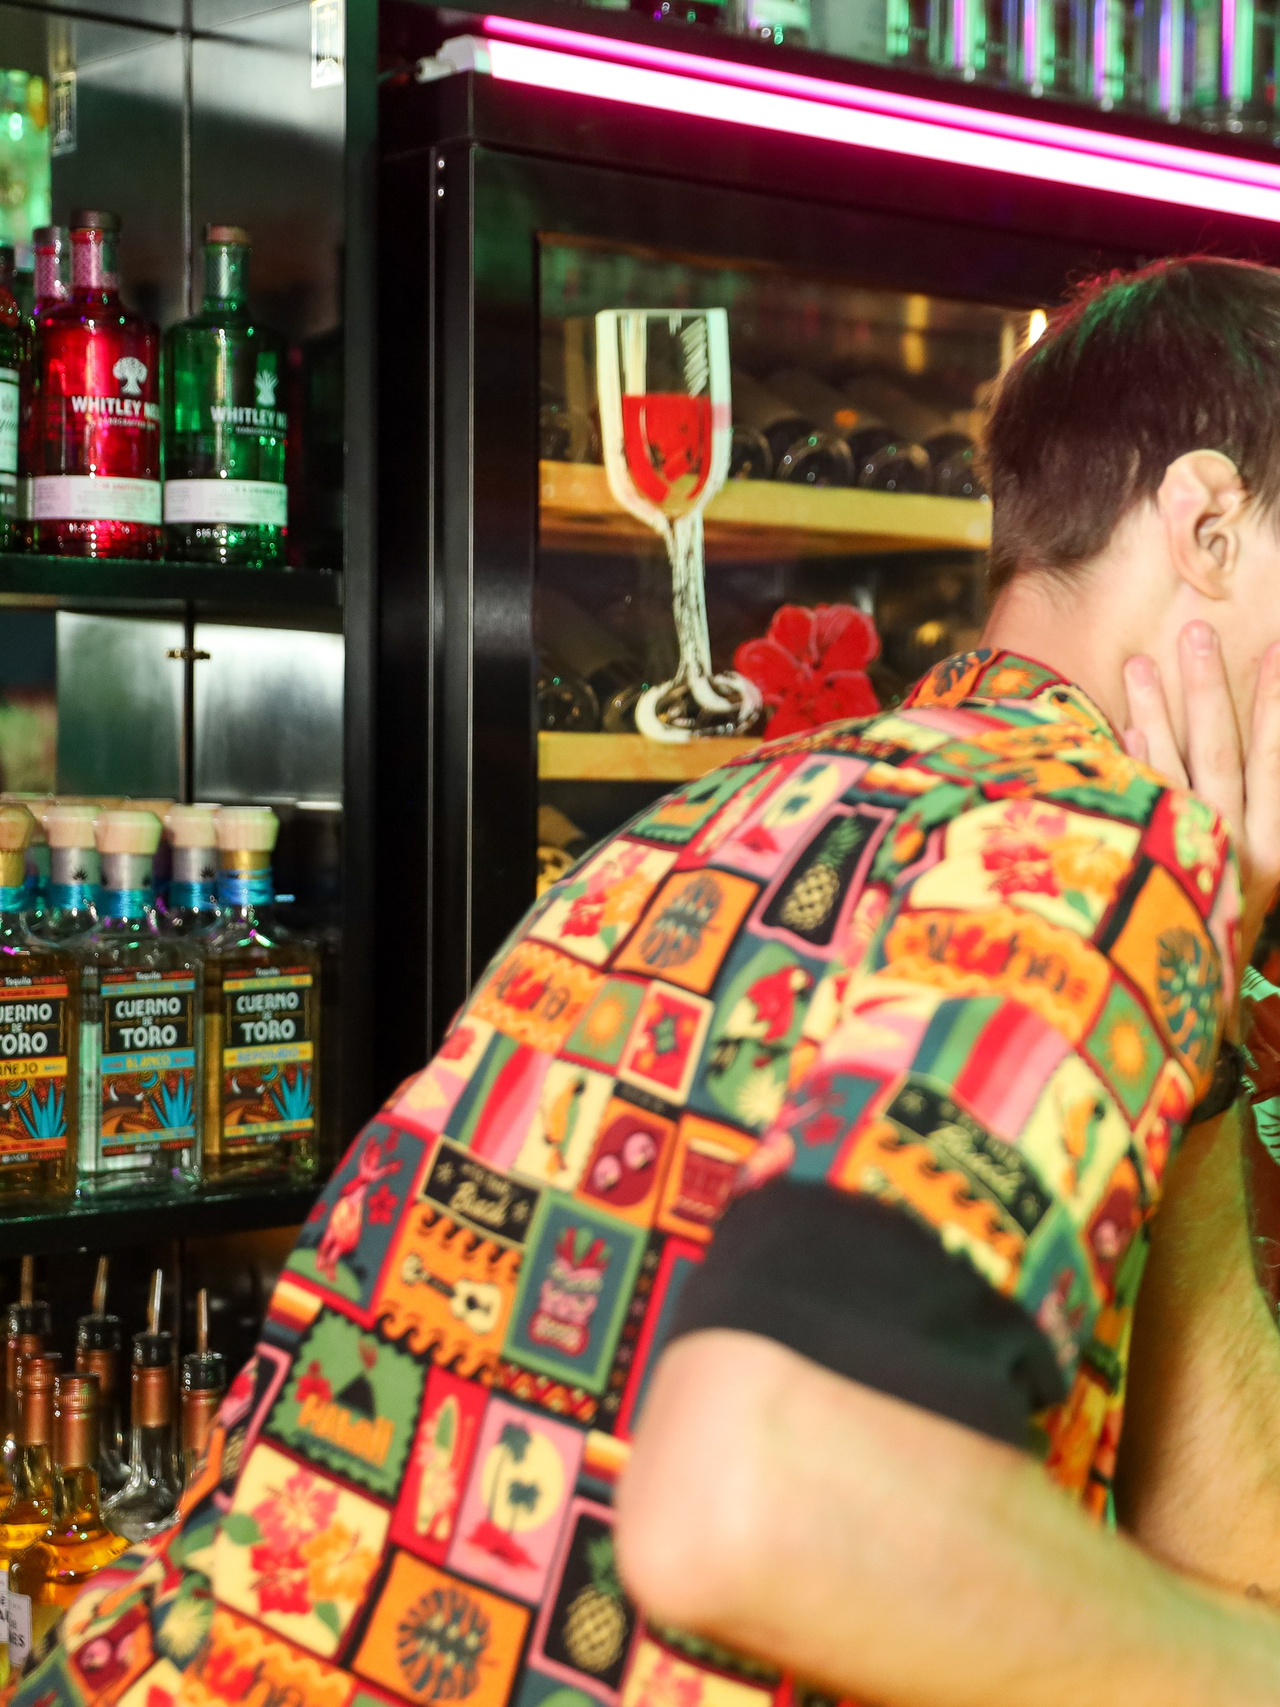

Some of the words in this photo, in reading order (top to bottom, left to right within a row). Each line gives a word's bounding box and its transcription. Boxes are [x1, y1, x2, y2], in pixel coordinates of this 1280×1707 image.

[71, 396, 142, 417] WHITLEY
[210, 406, 275, 427] WHITLEY
[4, 976, 32, 988] Tequila
[135, 971, 162, 981] Tequila
[115, 997, 182, 1019] CUERNO
[236, 991, 299, 1014] CUERNO
[11, 1023, 23, 1033] DE
[119, 1024, 178, 1049] TORO
[240, 1018, 296, 1043] TORO
[0, 1031, 48, 1055] ORO
[125, 1054, 171, 1070] BLANCO
